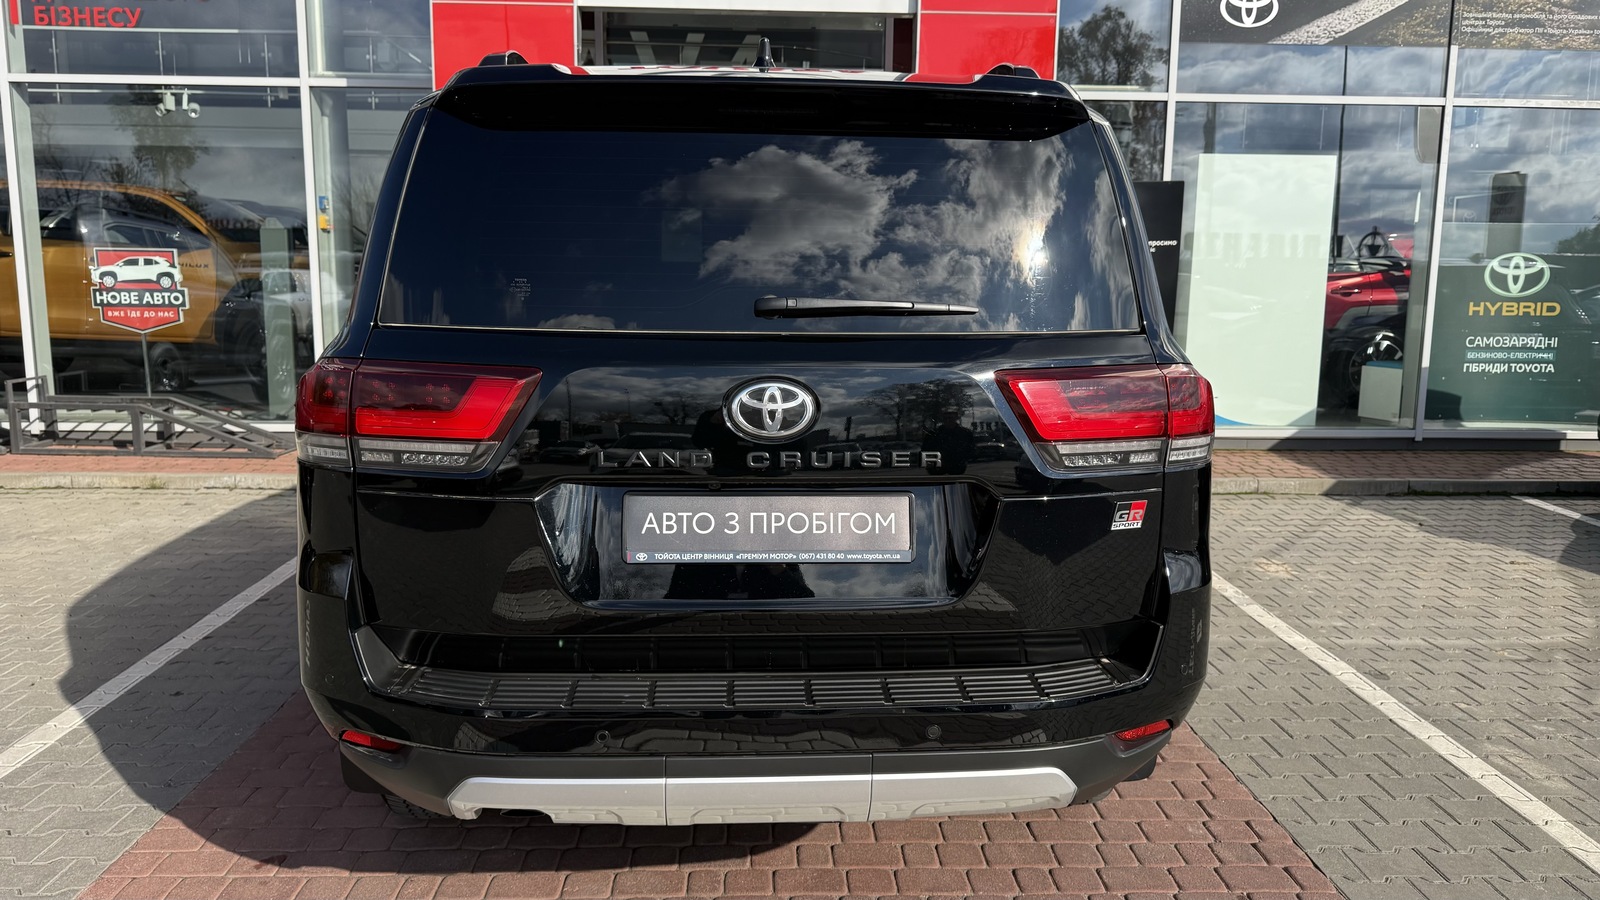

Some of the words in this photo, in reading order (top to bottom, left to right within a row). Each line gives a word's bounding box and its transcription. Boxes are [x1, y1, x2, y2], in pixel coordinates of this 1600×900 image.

[33, 5, 141, 28] БІЗНЕСУ
[96, 291, 139, 305] НОВЕ
[142, 292, 184, 305] АВТО
[127, 310, 141, 318] ЇДЕ
[1468, 302, 1561, 316] HYBRID
[1466, 336, 1558, 349] САМОЗАРЯДНІ
[1463, 363, 1508, 374] ГІБРИДИ
[1509, 363, 1555, 373] TOYOTA
[597, 451, 713, 468] LAND
[746, 451, 943, 469] CRUISER
[1115, 510, 1144, 522] GR
[641, 512, 715, 535] АВТО
[724, 512, 740, 535] З
[749, 512, 896, 535] ПРОБІГОМ
[655, 552, 681, 560] ТОЙОТА
[682, 553, 703, 561] ЦЕНТР
